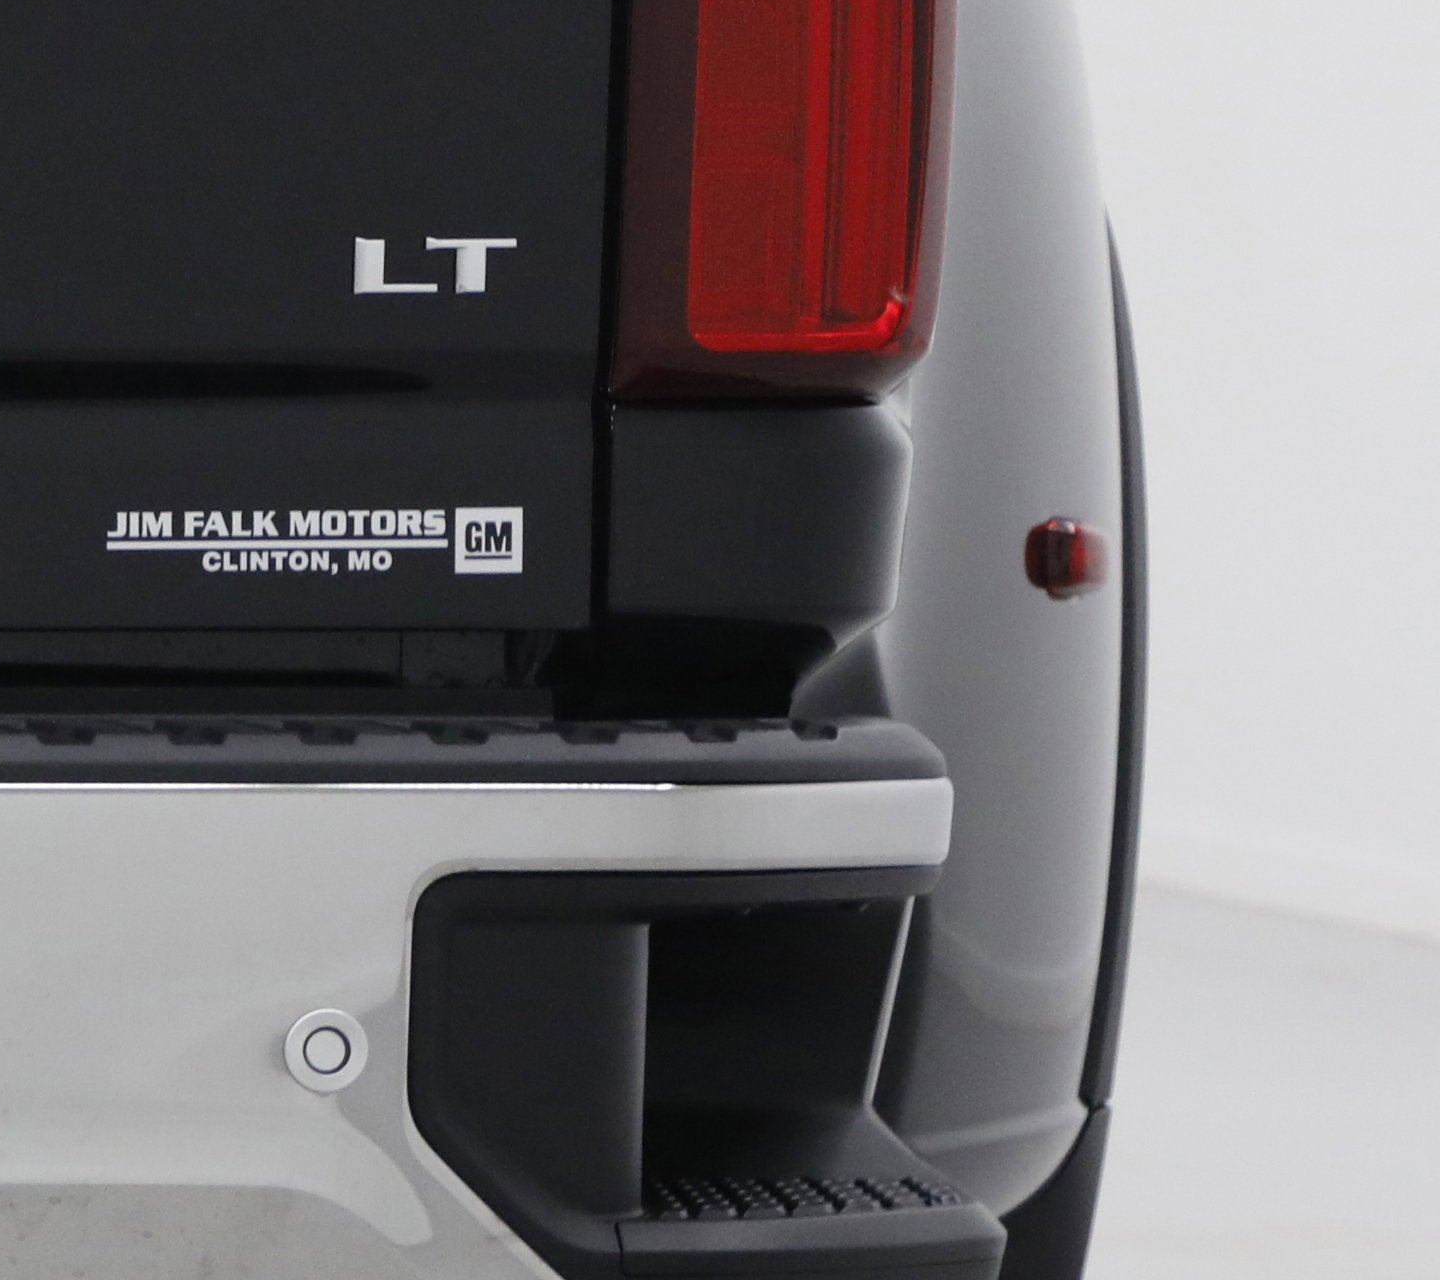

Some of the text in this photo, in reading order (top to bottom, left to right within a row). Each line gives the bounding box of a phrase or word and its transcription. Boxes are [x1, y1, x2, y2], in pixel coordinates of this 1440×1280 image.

[353, 236, 518, 295] LT
[106, 508, 447, 538] JIM FALK MOTORS
[464, 521, 513, 553] GM
[201, 549, 393, 575] CLINTON, MO
